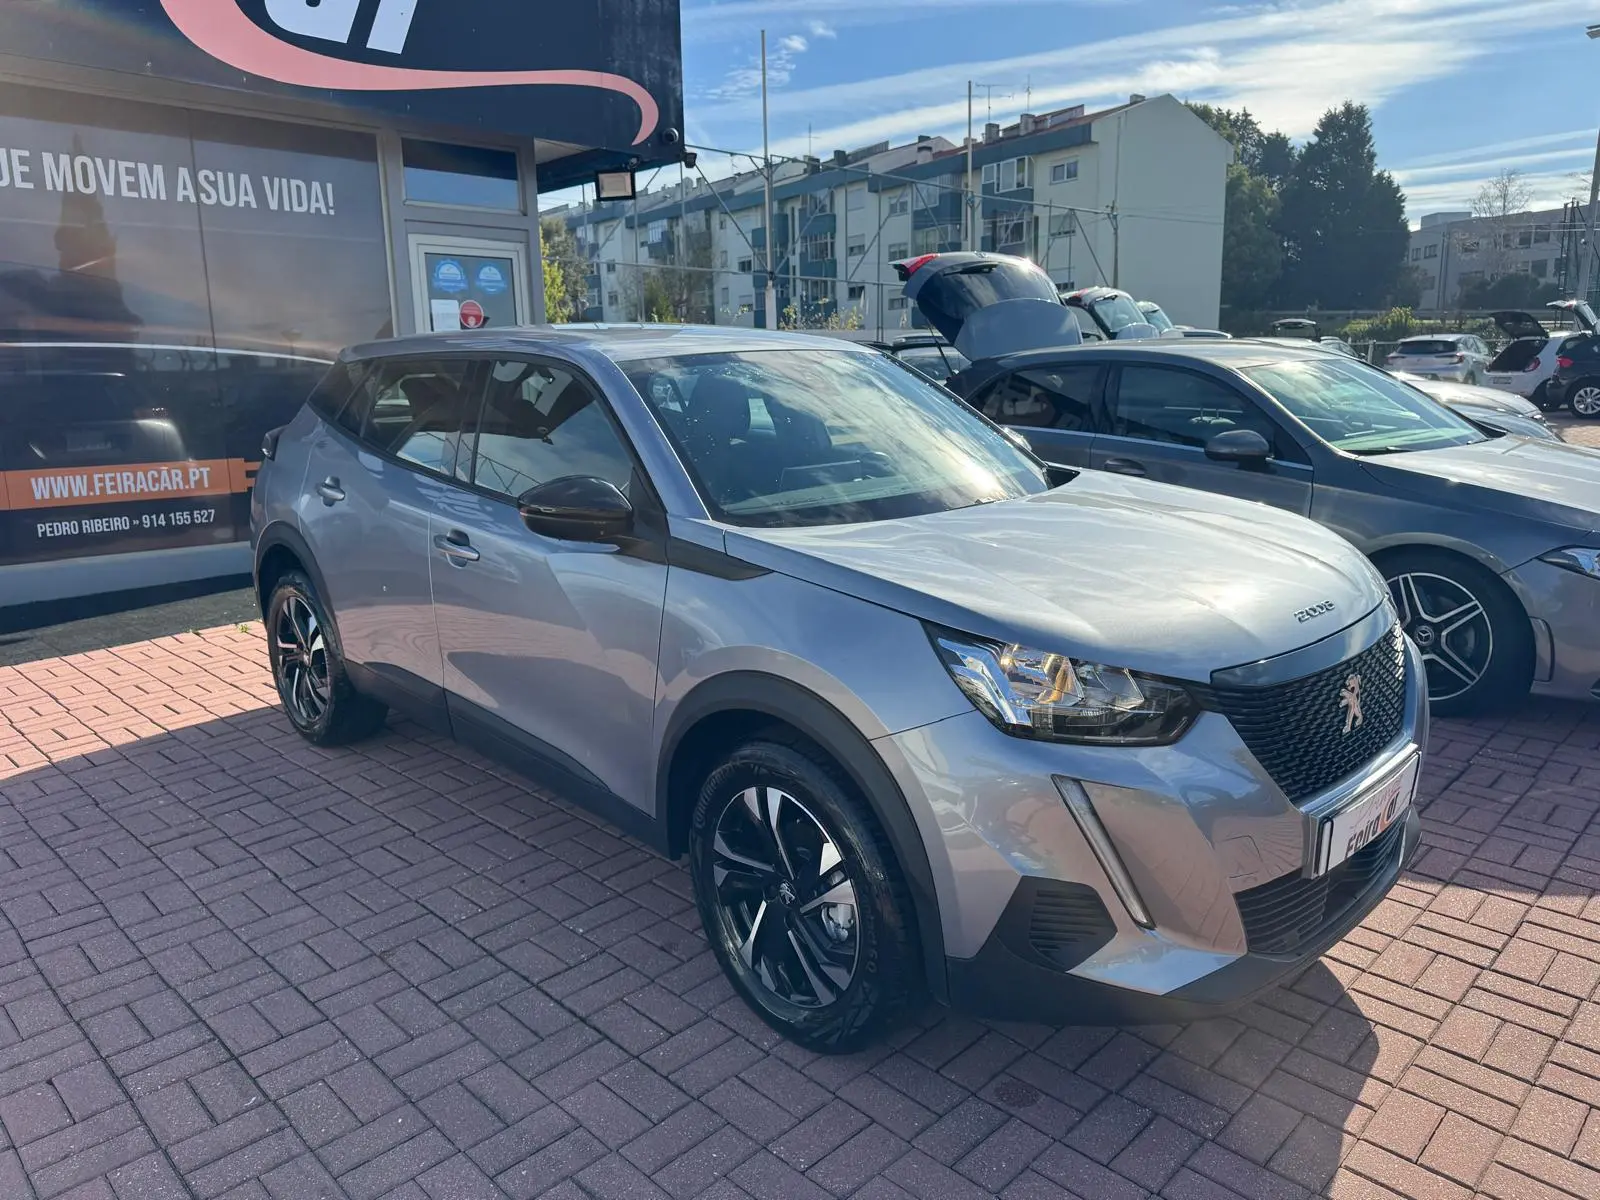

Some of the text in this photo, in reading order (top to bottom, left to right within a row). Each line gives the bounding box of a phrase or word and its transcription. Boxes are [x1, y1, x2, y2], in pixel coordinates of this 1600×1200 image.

[42, 151, 167, 201] MOVEM
[262, 175, 336, 216] VIDA!
[37, 520, 79, 538] PEDRO
[82, 516, 130, 533] RIBEIRO
[142, 513, 167, 529] 914
[169, 511, 191, 526] 155
[193, 509, 216, 524] 527
[1293, 599, 1336, 624] 2008
